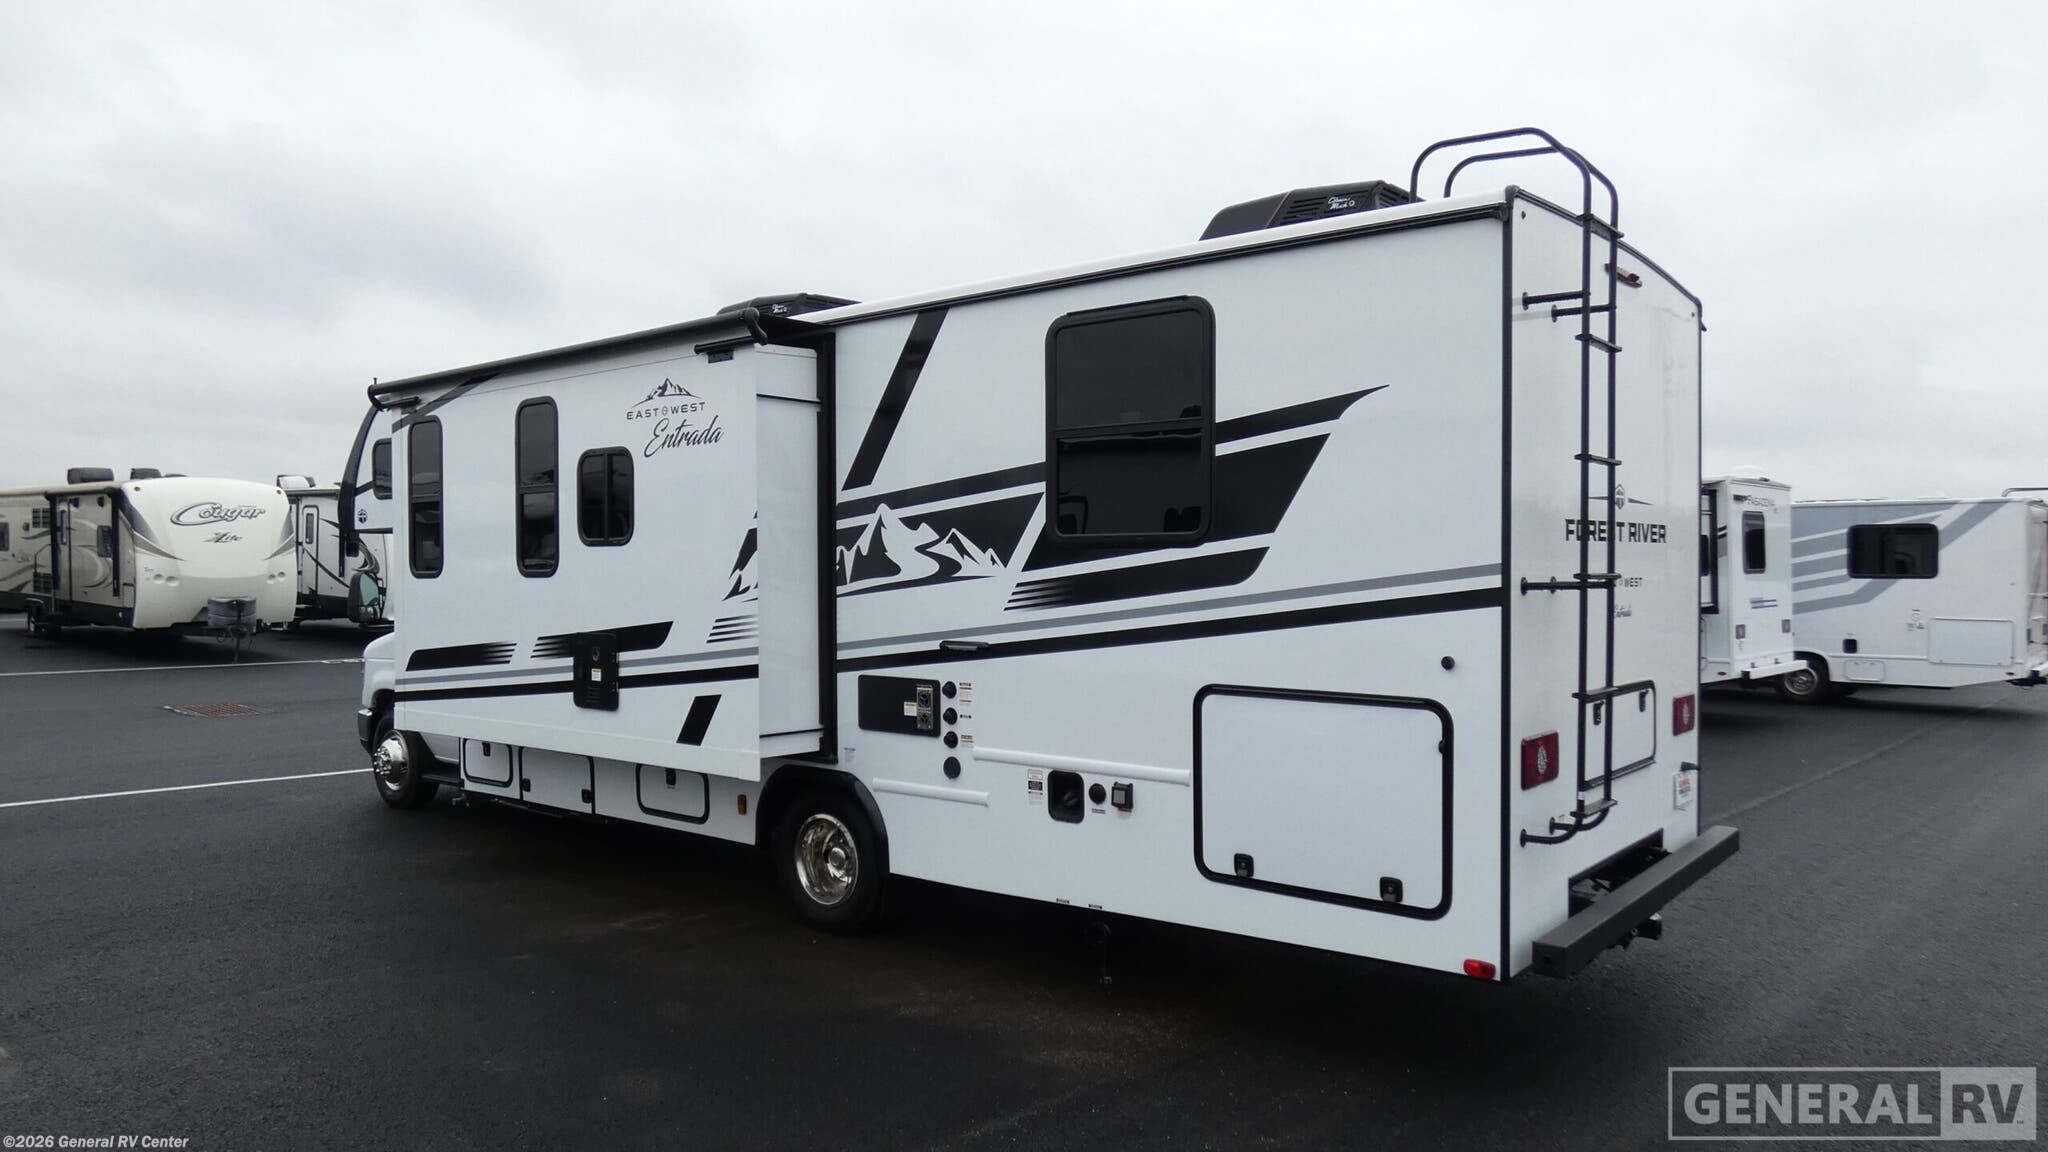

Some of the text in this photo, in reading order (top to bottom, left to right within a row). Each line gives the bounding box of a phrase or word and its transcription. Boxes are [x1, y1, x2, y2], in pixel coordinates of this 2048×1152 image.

[626, 401, 706, 420] EAST WEST
[643, 414, 725, 458] Entrada
[170, 502, 266, 527] Cougar
[1564, 519, 1667, 543] FRET RIVER
